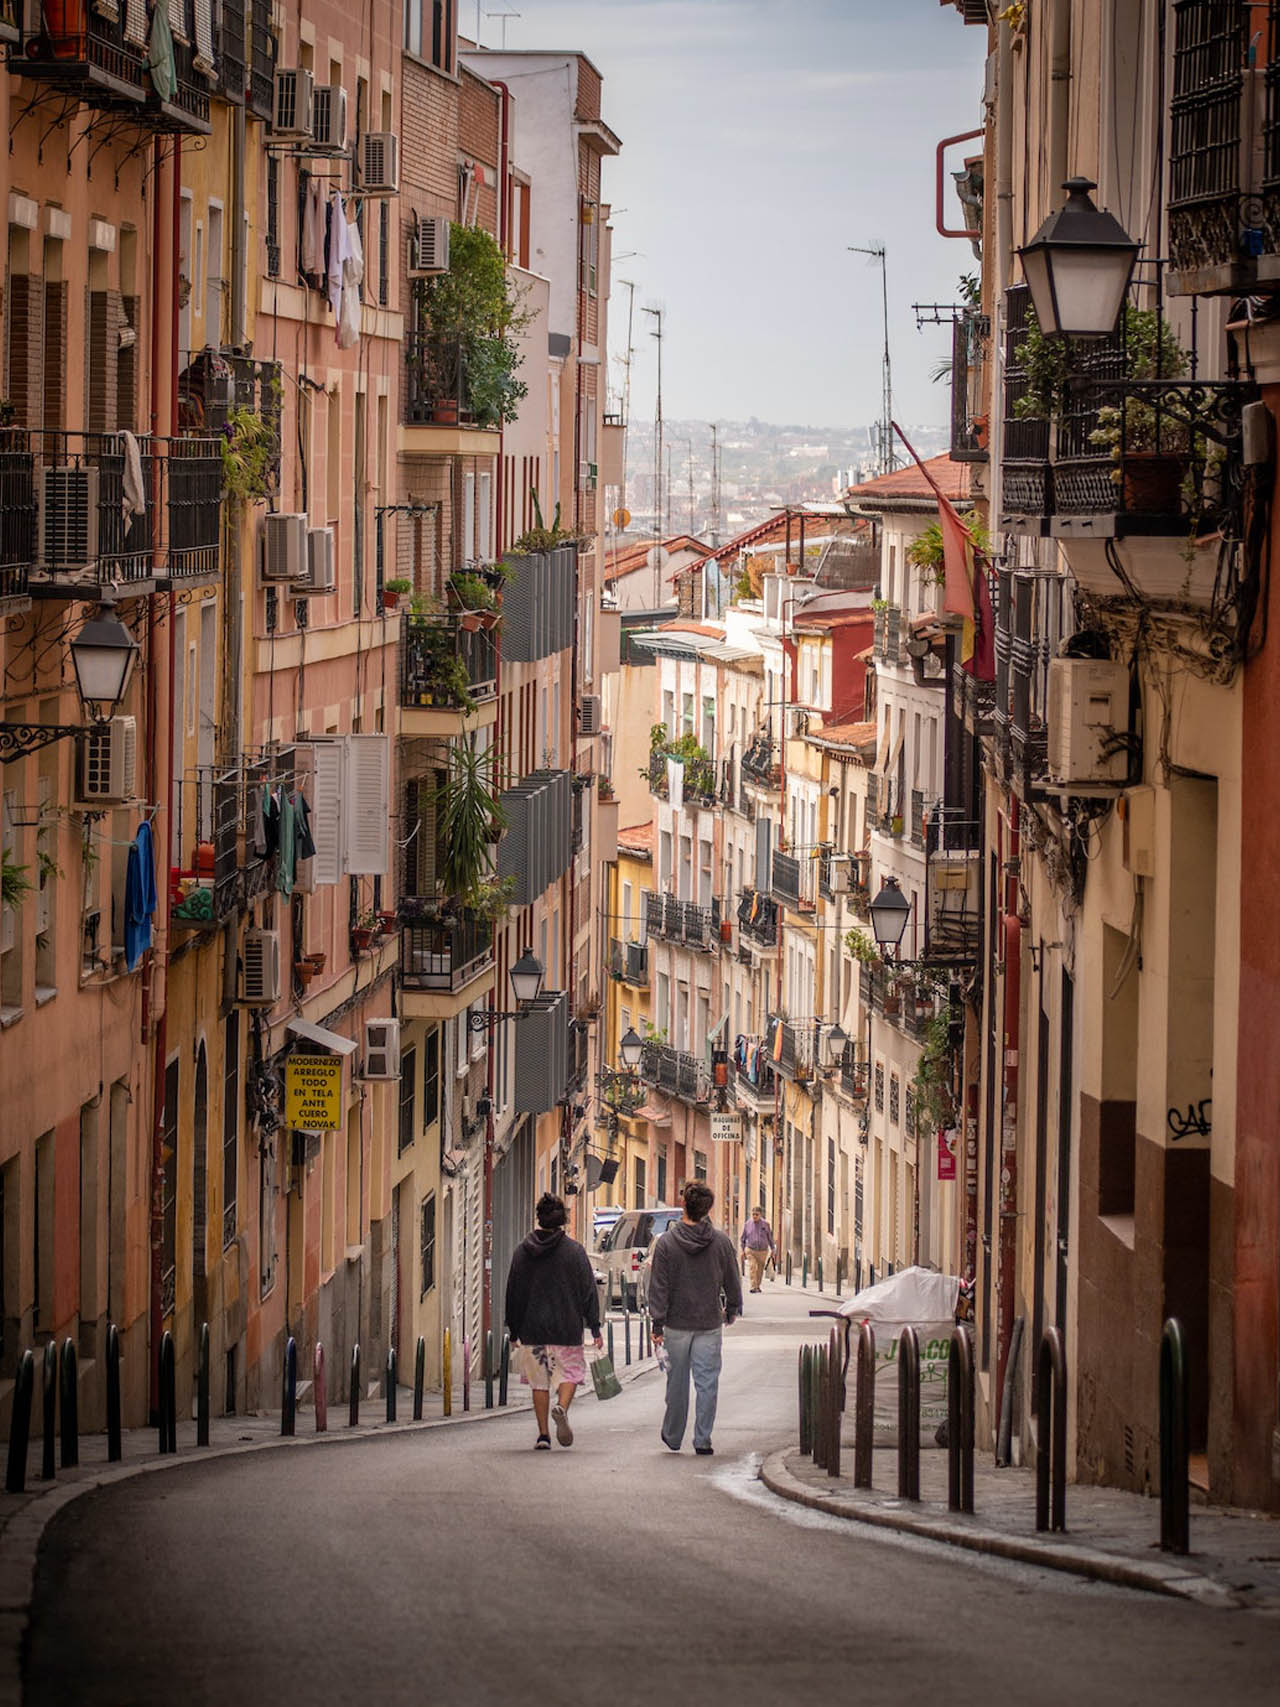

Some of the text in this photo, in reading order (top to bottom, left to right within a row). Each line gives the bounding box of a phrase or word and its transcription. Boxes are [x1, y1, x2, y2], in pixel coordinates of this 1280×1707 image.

[287, 1057, 341, 1066] MODERNIZO
[293, 1068, 336, 1077] ARREGLO
[301, 1079, 328, 1087] TODO
[294, 1089, 334, 1097] EN TELA
[302, 1099, 325, 1107] ANTE
[298, 1109, 328, 1118] CUERO
[291, 1119, 336, 1128] Y NOVAK
